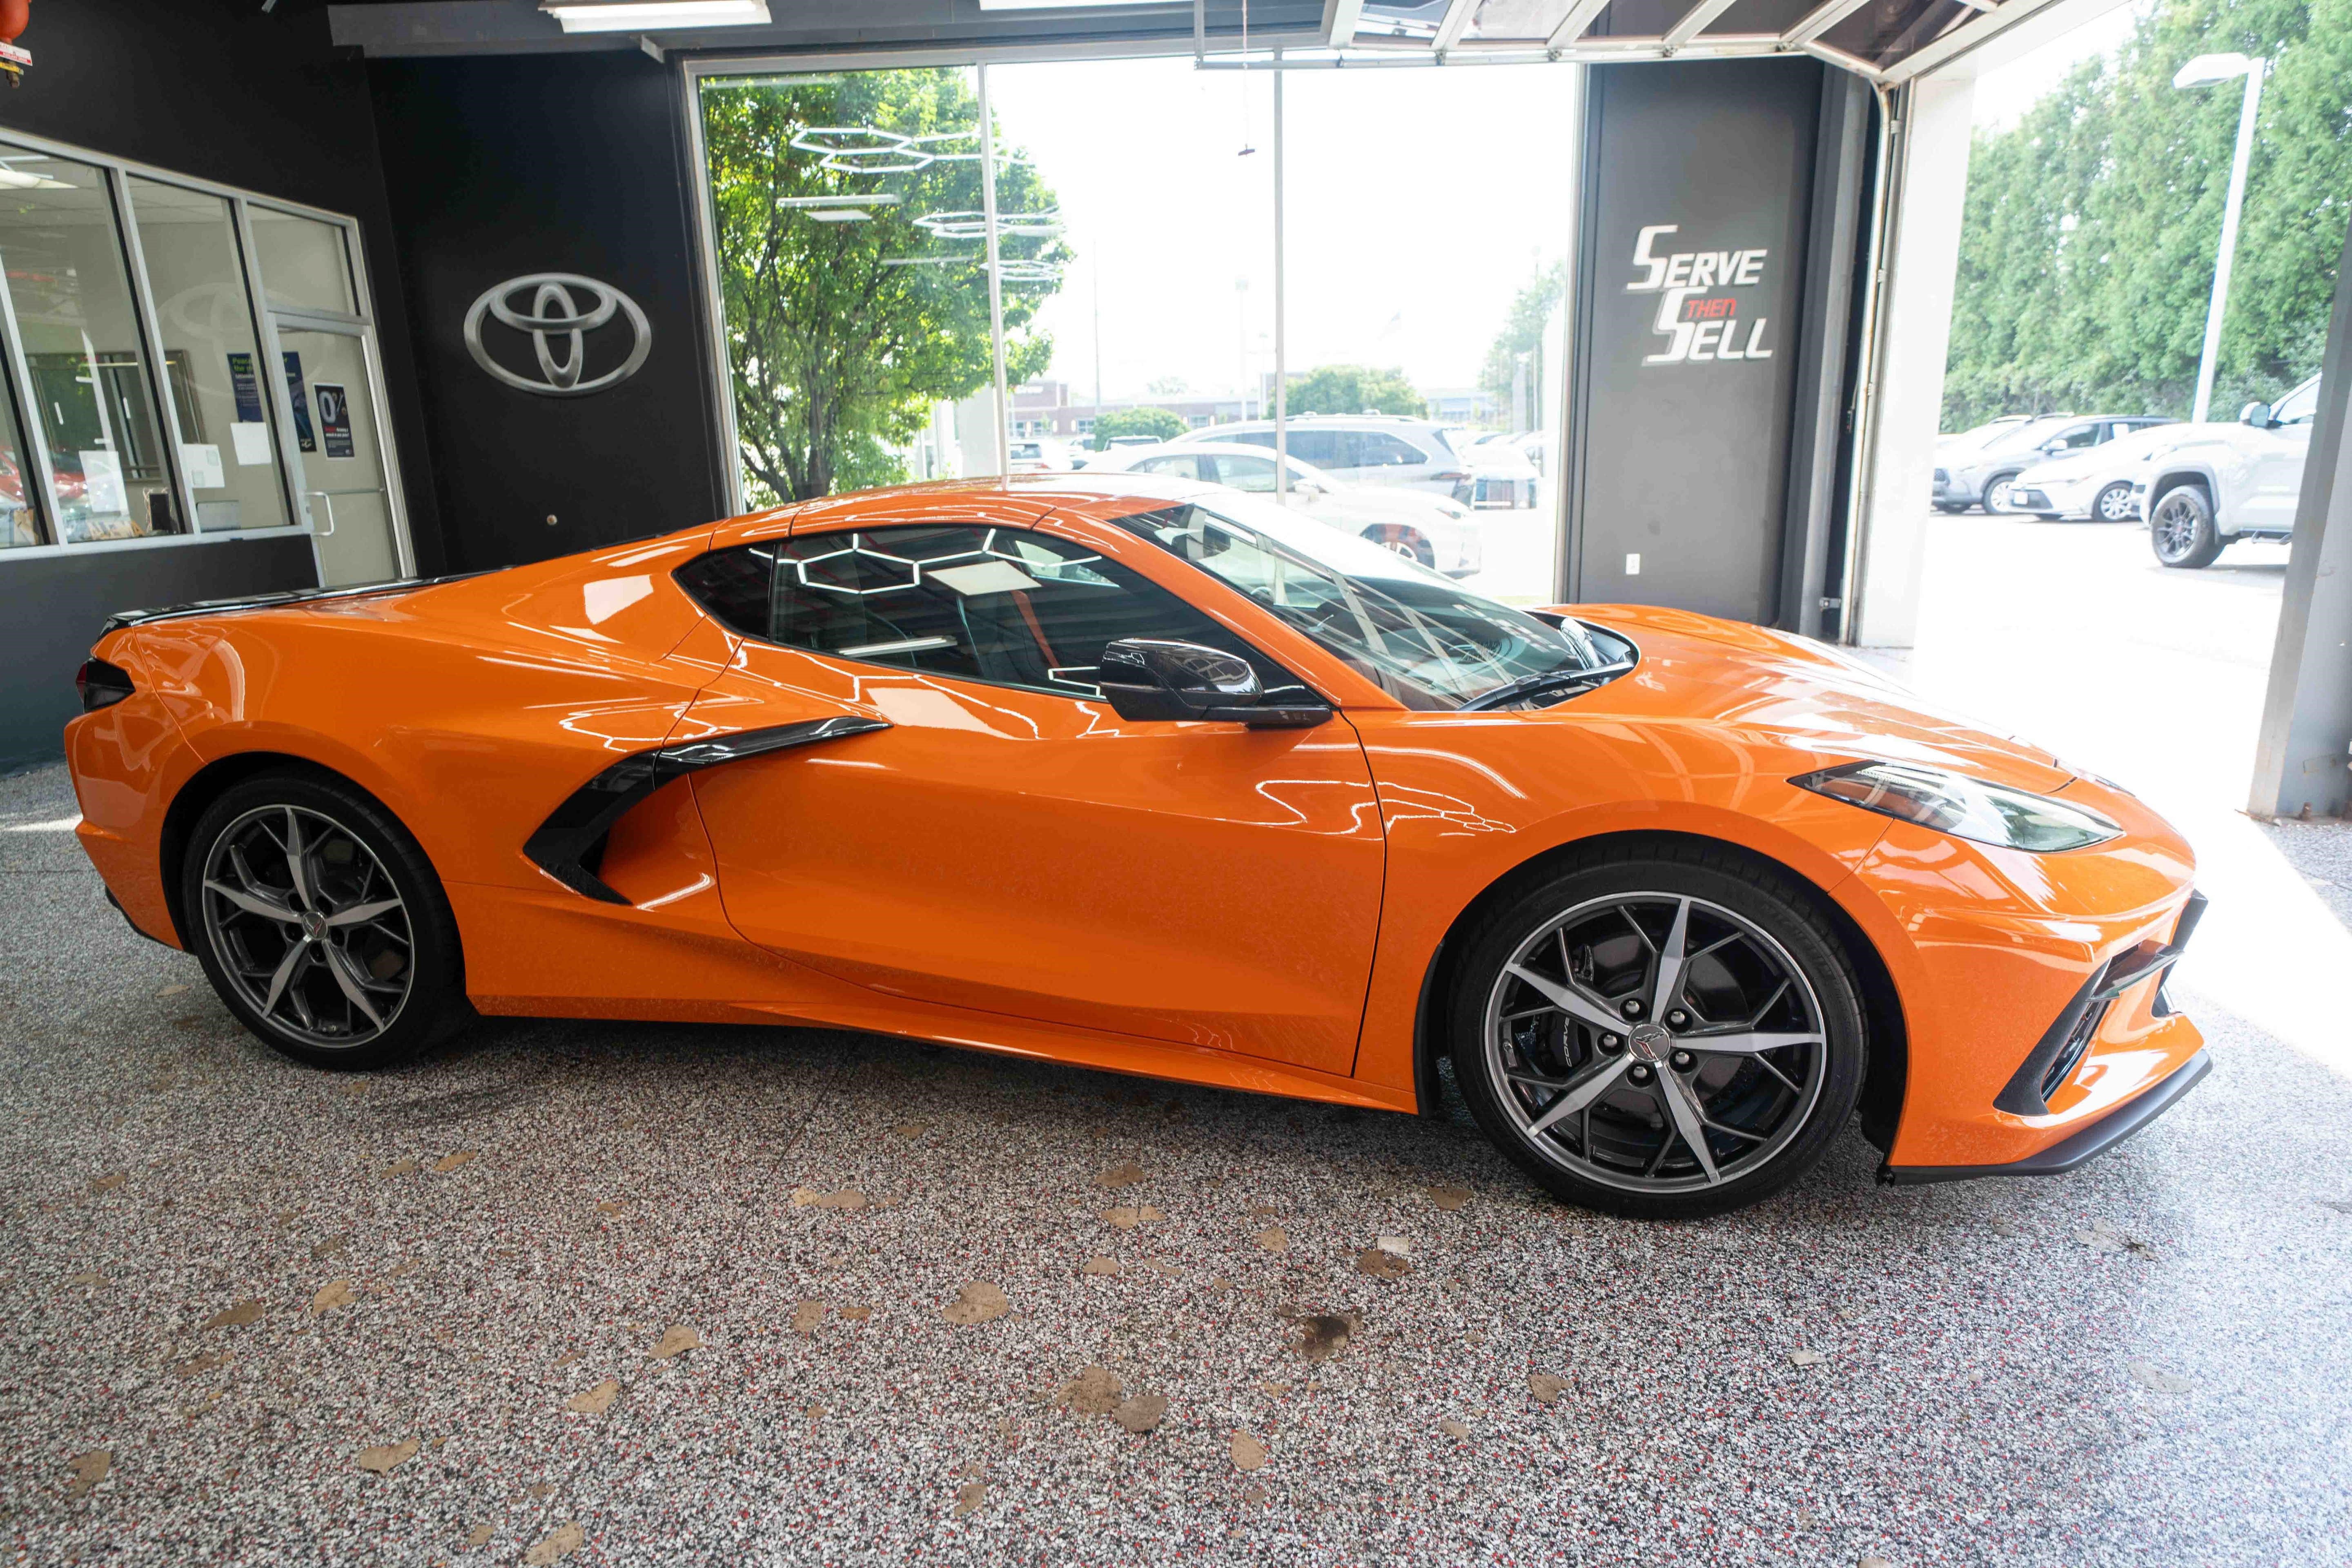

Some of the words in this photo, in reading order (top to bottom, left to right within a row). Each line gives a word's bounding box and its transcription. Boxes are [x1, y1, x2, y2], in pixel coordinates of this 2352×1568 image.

[1626, 225, 1768, 290] SERVE
[1646, 286, 1773, 363] SELL
[1688, 298, 1736, 318] THEN
[319, 391, 347, 423] 0%
[1563, 1016, 1572, 1067] CORVE
